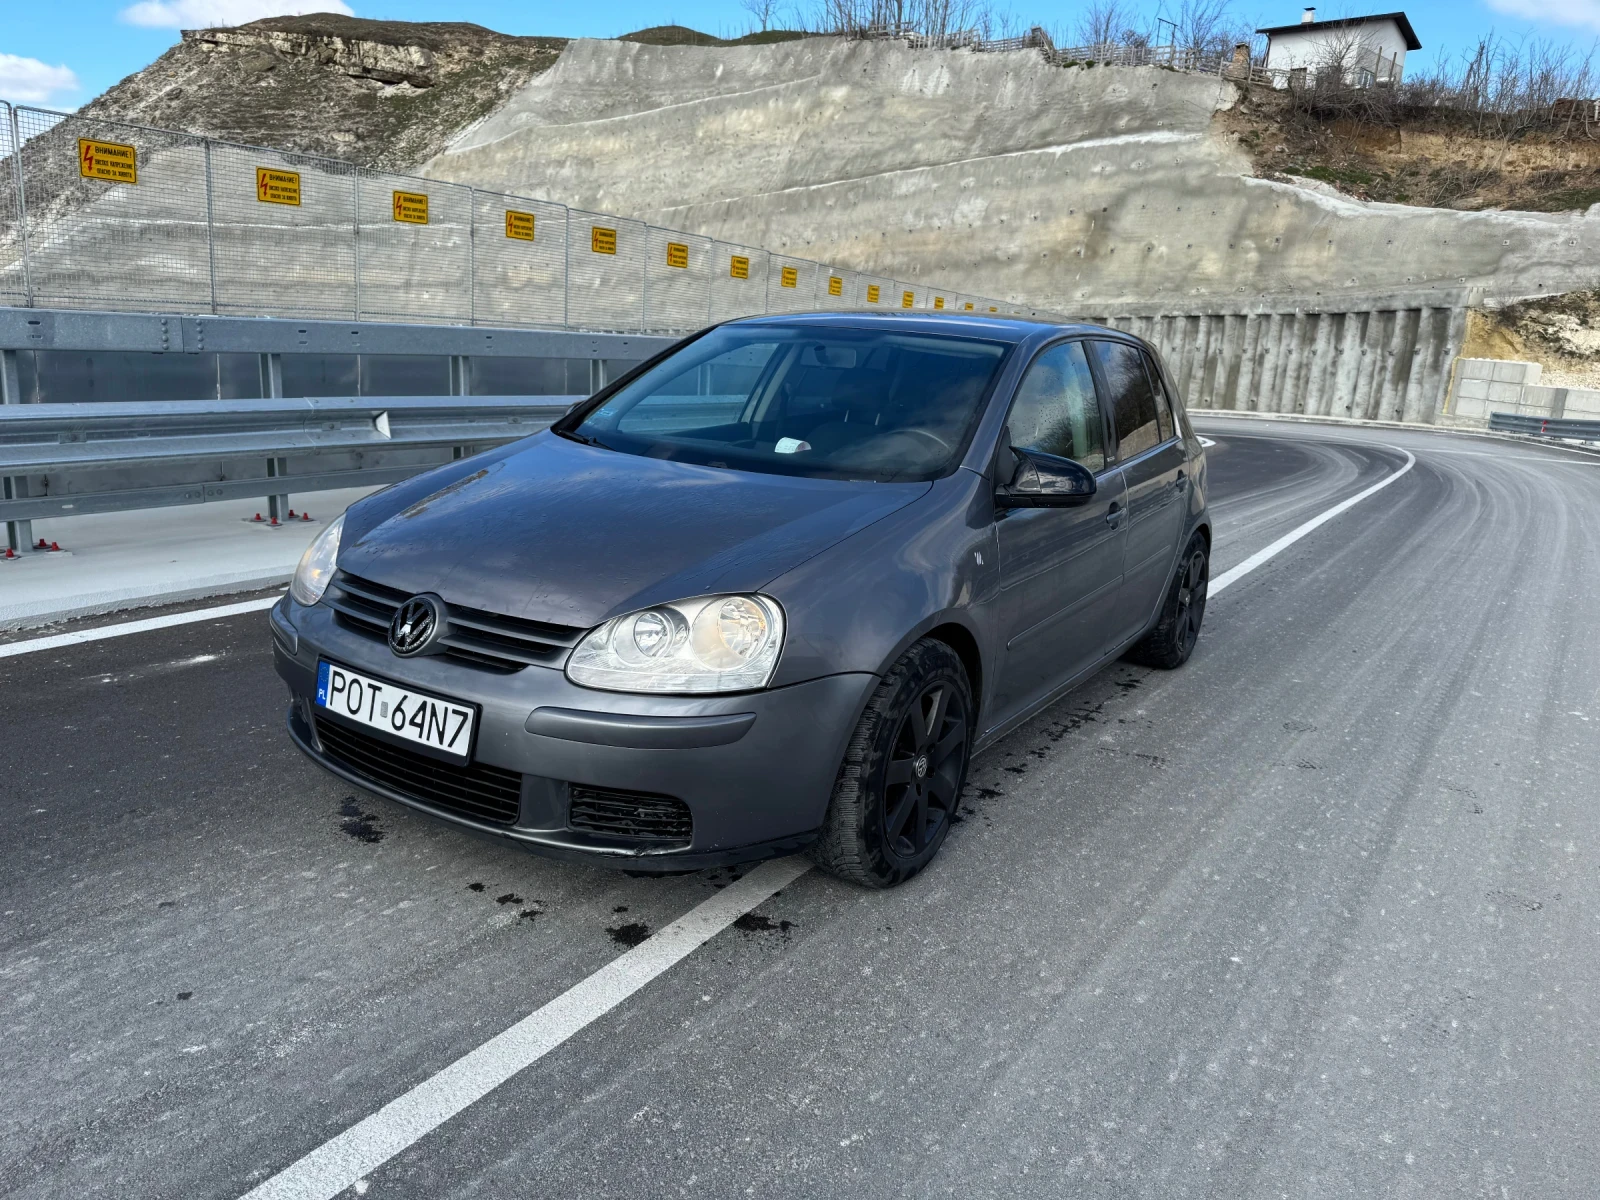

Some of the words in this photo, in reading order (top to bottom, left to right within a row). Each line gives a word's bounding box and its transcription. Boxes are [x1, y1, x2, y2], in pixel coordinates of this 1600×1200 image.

[95, 146, 132, 158] ВНИМАНИЕ!
[318, 688, 325, 700] PL
[330, 670, 382, 722] POT
[391, 695, 469, 748] 64N7
